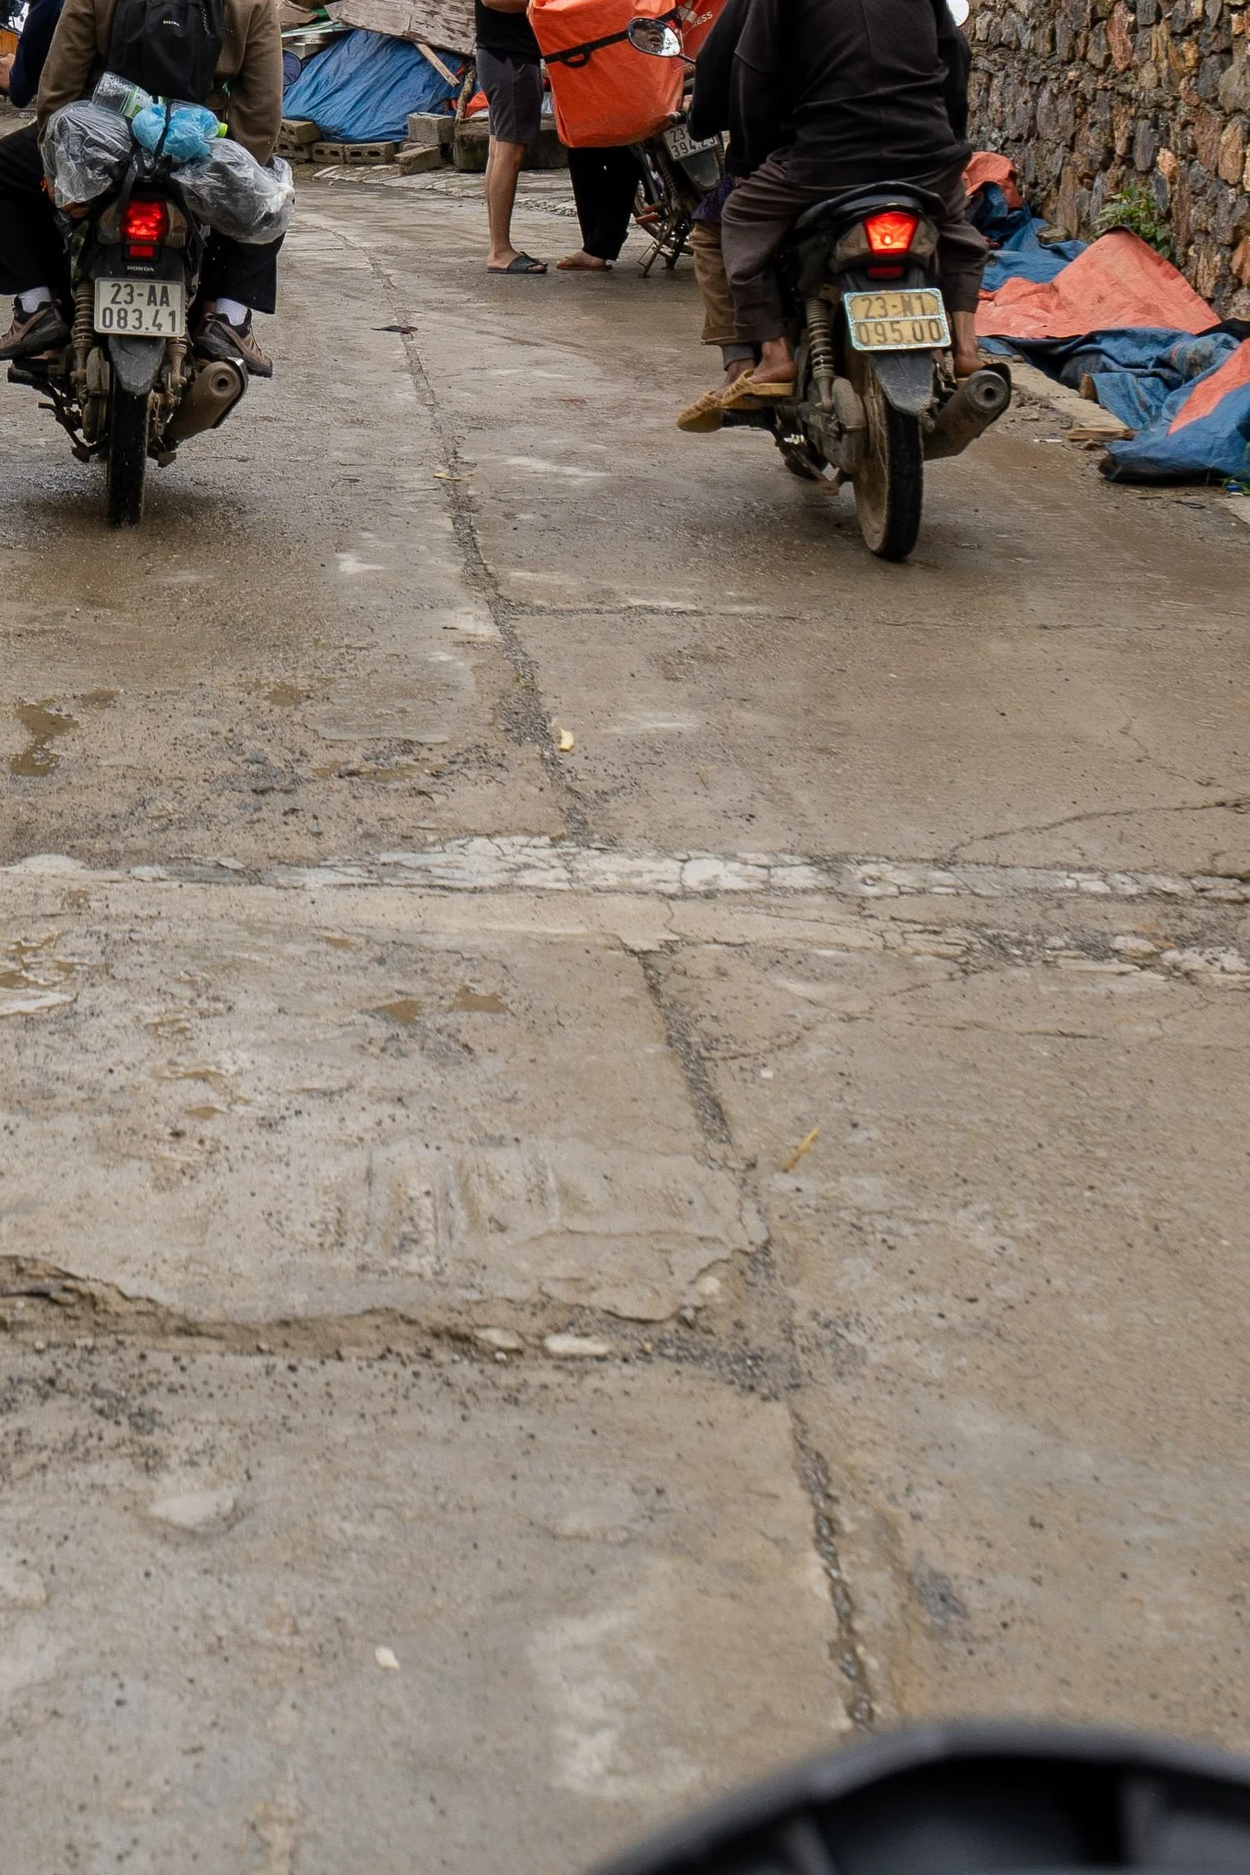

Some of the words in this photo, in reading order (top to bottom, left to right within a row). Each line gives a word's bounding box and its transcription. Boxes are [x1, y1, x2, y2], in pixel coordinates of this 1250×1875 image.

[126, 265, 155, 273] HONDA
[110, 282, 170, 308] 23-AA
[102, 306, 177, 333] 083.41
